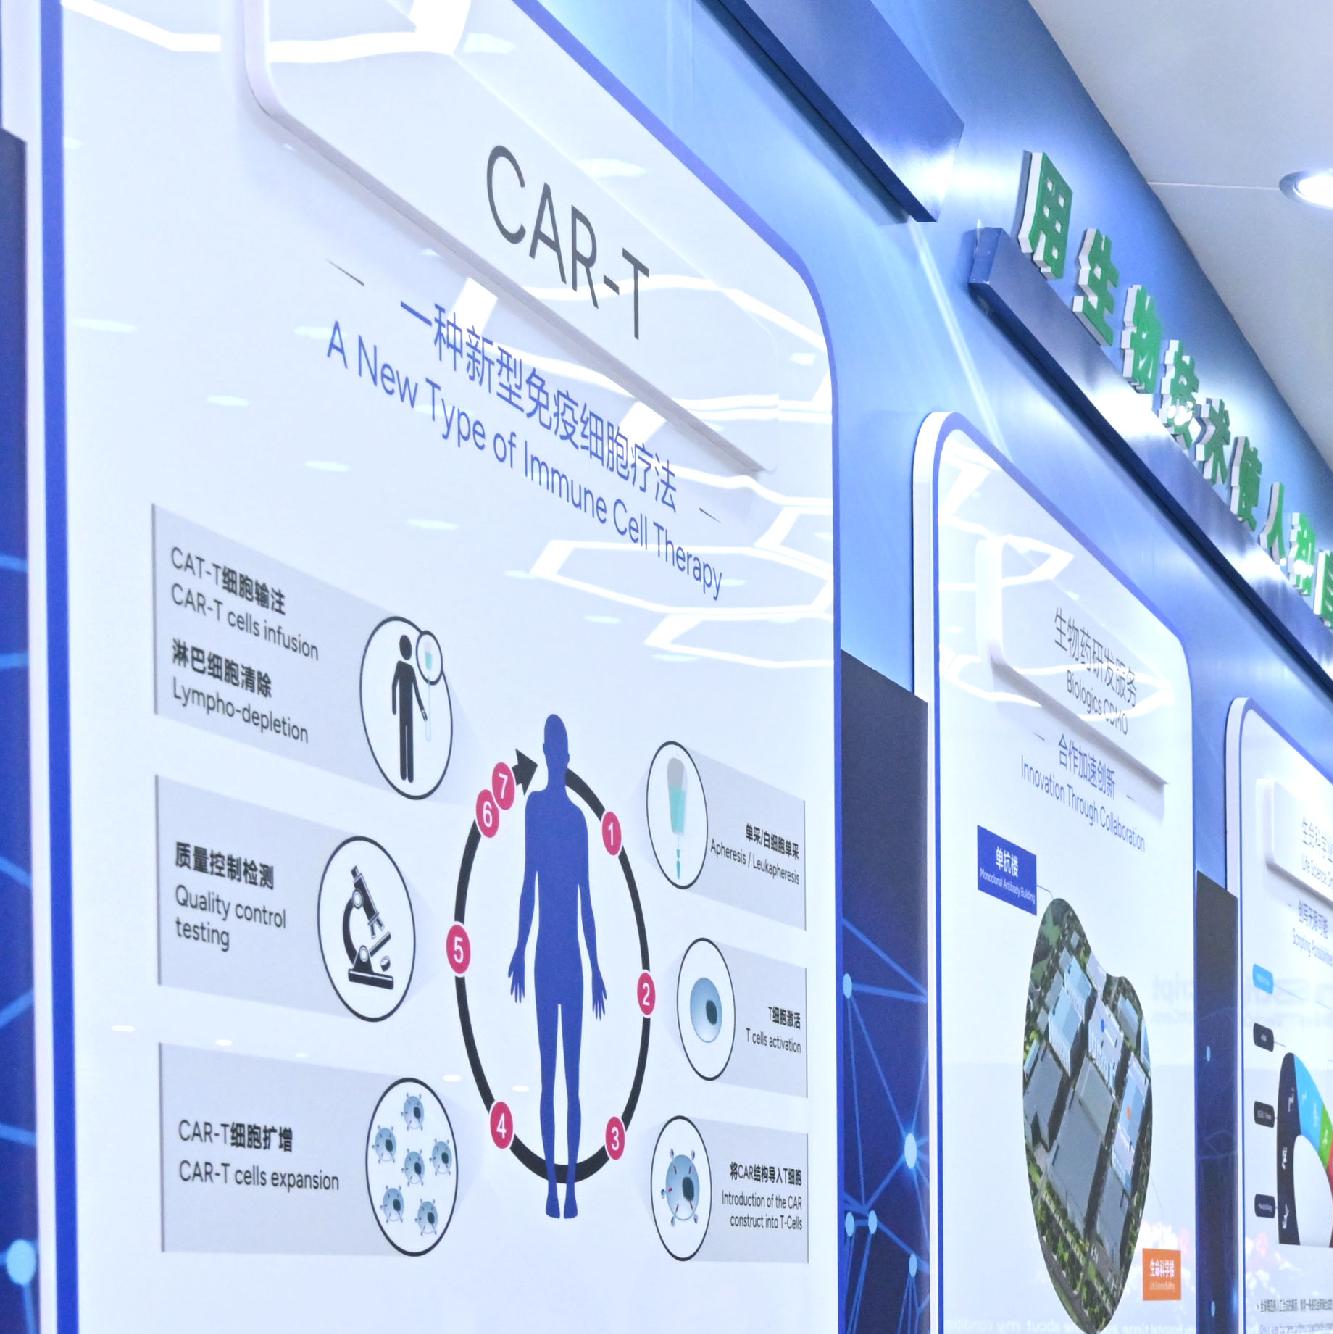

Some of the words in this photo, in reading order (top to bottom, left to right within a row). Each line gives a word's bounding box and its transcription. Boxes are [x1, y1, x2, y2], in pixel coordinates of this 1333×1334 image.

[487, 146, 649, 340] CAR-T
[400, 300, 676, 512] 一种新型免疫细胞疗法
[327, 322, 348, 369] A
[358, 336, 418, 408] New
[425, 378, 486, 450] Type
[493, 432, 516, 468] of
[525, 440, 607, 524] Immune
[613, 499, 647, 549] Cell
[653, 522, 722, 598] Therapy
[170, 546, 286, 616] CAT-T细胞输注
[171, 582, 223, 621] CAR-T
[228, 611, 260, 637] cells
[264, 620, 318, 660] infusion
[172, 638, 272, 698] 淋巴细胞清除
[173, 679, 308, 744] Lympho-depletion
[498, 774, 509, 799] 7
[1022, 755, 1065, 803] Innovation
[483, 804, 493, 826] 6
[607, 822, 615, 845] 1
[174, 841, 274, 890] 质量控制检测
[710, 838, 746, 865] Apheresis
[753, 855, 799, 884] Leukapheresis
[175, 884, 230, 923] Quality
[235, 904, 286, 928] control
[175, 917, 230, 952] testing
[454, 936, 464, 963] 5
[642, 983, 650, 1006] 2
[746, 1028, 751, 1042] T
[752, 1031, 767, 1046] cells
[769, 1036, 801, 1054] activation
[178, 1120, 293, 1152] CAR-T细胞扩增
[495, 1114, 507, 1139] 4
[612, 1127, 621, 1150] 3
[179, 1160, 230, 1184] CAR-T
[234, 1165, 267, 1186] cells
[270, 1170, 339, 1192] expansion
[722, 1190, 765, 1207] Introduction
[767, 1194, 774, 1208] of
[775, 1195, 786, 1209] the
[788, 1196, 801, 1209] CAR
[730, 1214, 764, 1228] construct
[766, 1215, 778, 1228] into
